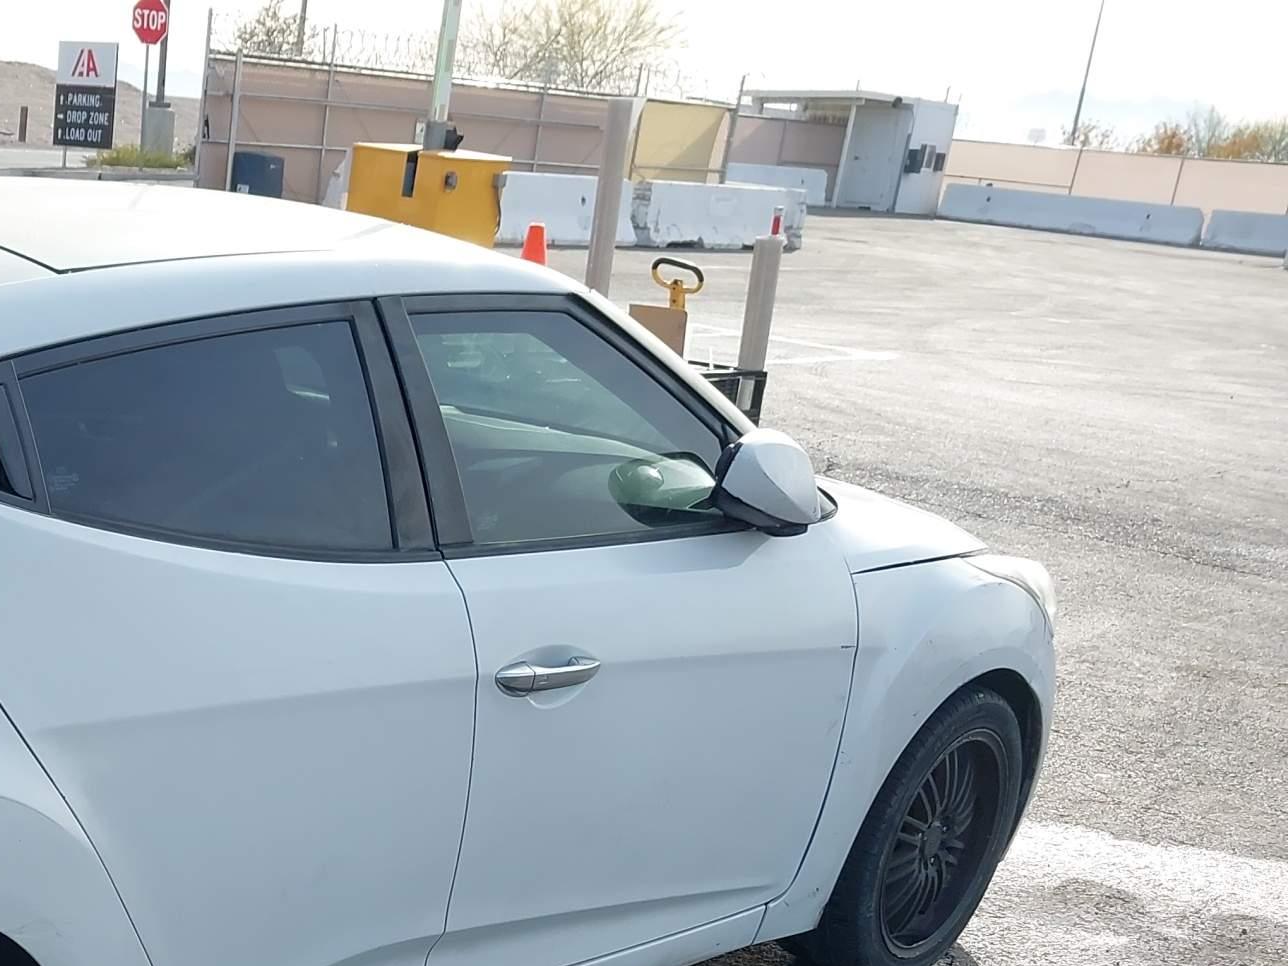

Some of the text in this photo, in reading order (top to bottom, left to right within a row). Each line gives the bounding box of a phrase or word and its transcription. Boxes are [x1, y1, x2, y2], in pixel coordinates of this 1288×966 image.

[133, 8, 166, 31] STOP
[67, 92, 101, 107] PARKING
[66, 110, 109, 126] DROP ZONE
[65, 127, 102, 142] LOAD OUT
